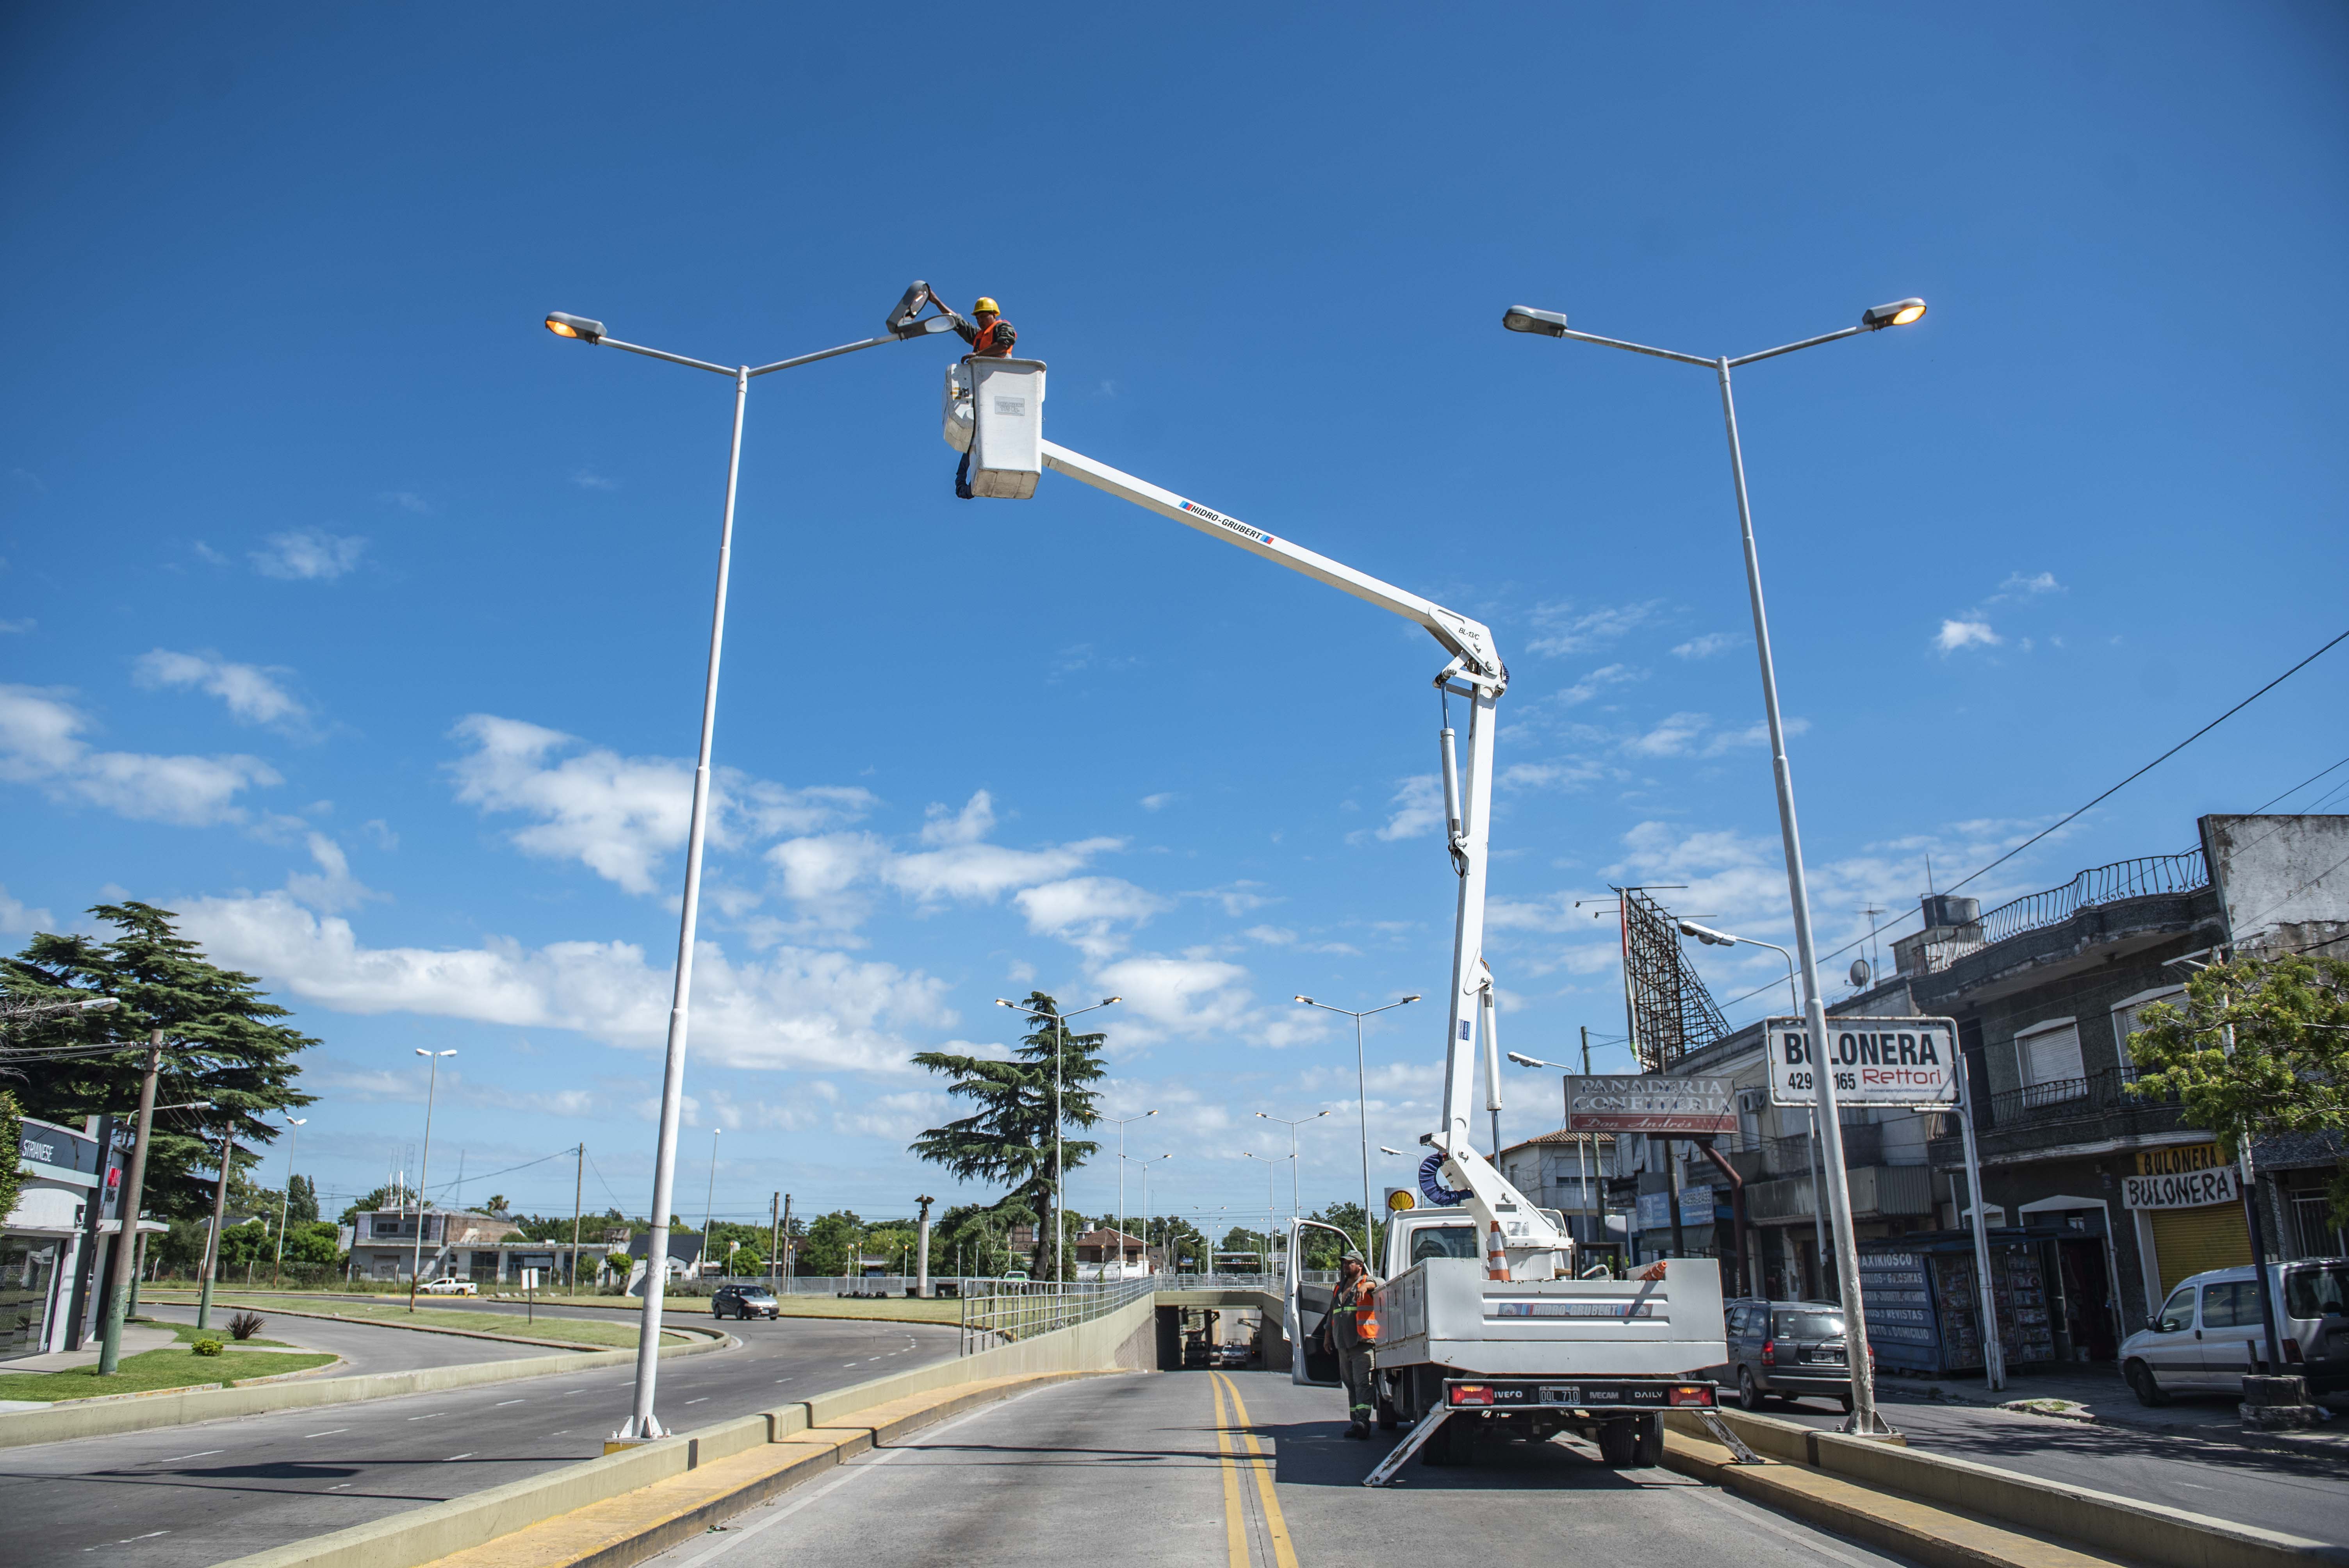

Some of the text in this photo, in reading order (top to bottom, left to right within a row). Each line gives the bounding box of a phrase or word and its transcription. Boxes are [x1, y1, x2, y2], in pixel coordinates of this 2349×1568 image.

[1191, 506, 1263, 539] HIDRO-GRUBERT
[1459, 627, 1480, 640] BL-13/C
[1862, 1069, 1941, 1084] Rettori
[1579, 1079, 1724, 1094] PANADERIA
[1573, 1096, 1732, 1113] CONFITERIA
[1583, 1117, 1619, 1129] Don
[1628, 1118, 1692, 1129] Andrés
[22, 1139, 54, 1162] STRIANESE
[2144, 1146, 2218, 1176] BULONERA
[2129, 1171, 2231, 1206] BULONERA
[1534, 1304, 1618, 1316] HIDRO-GRUBERT
[1887, 1310, 1923, 1320] REVISTAS
[1892, 1326, 1929, 1340] DOMICILIO
[1562, 1391, 1579, 1402] 710
[1589, 1391, 1619, 1399] IVECAM
